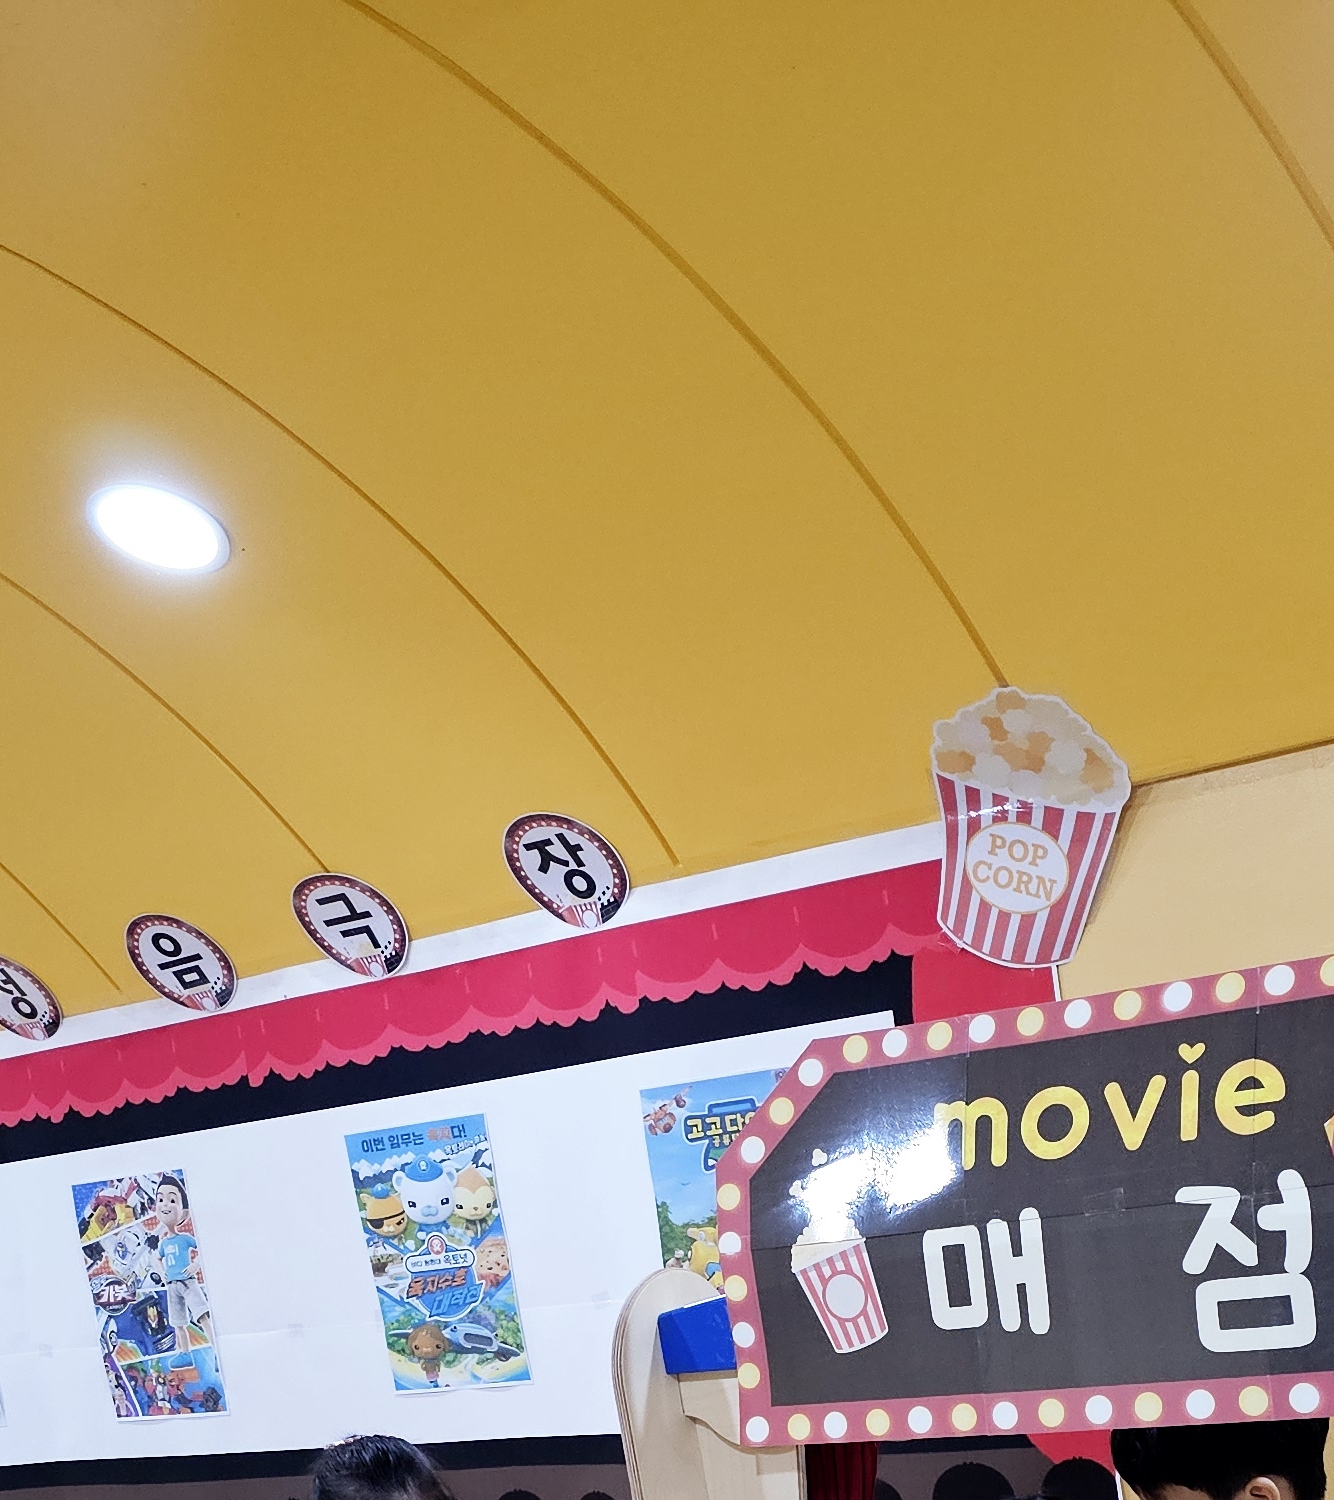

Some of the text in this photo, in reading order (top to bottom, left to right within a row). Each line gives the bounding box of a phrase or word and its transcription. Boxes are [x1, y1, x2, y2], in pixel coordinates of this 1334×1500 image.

[988, 833, 1048, 867] POP
[972, 860, 1057, 902] CORN
[150, 932, 206, 992] 음
[315, 891, 381, 950] 극
[523, 832, 597, 900] 장
[935, 1042, 1286, 1169] movie
[361, 1136, 386, 1153] 이번
[388, 1132, 424, 1149] 임무는
[443, 1252, 469, 1265] 옥토넛
